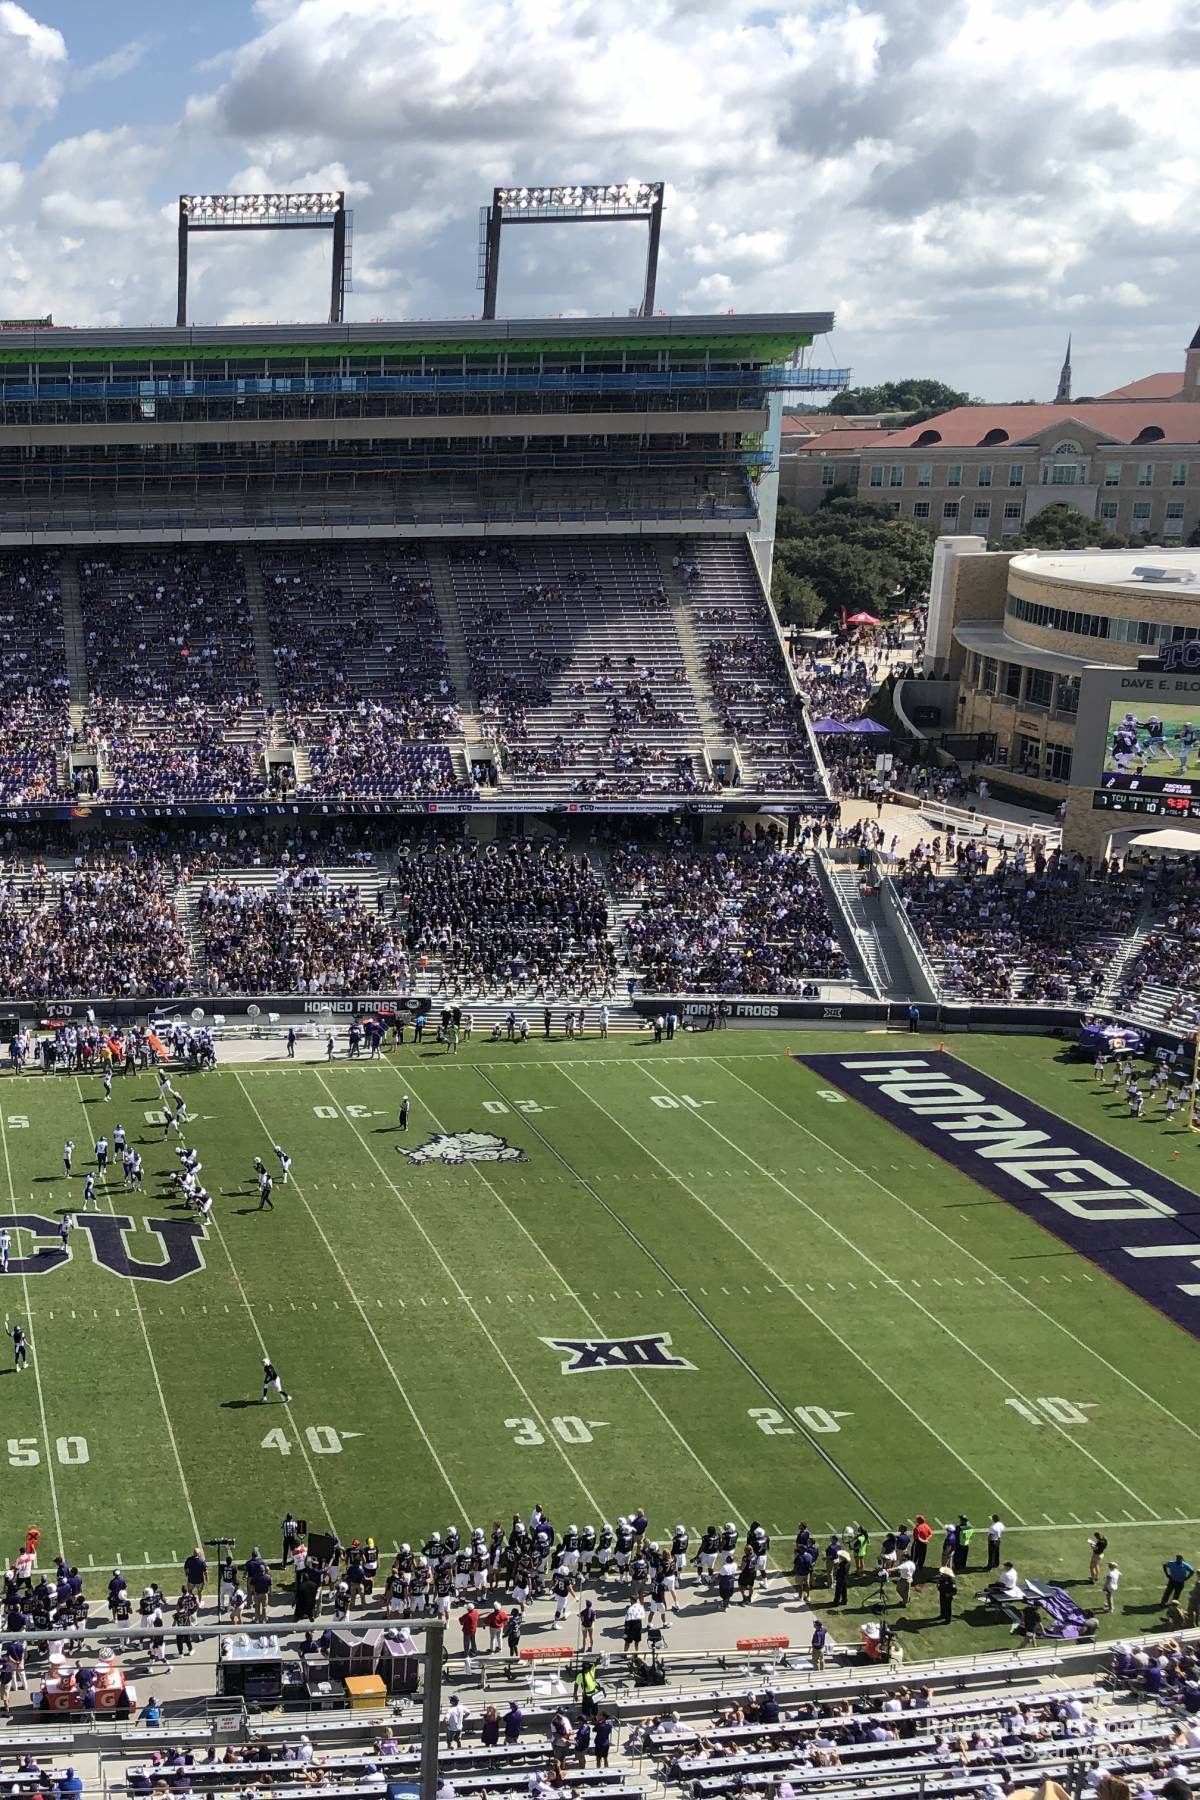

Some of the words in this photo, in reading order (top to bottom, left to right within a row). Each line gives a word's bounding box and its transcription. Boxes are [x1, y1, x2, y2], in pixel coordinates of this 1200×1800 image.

[1121, 679, 1153, 689] DAVE
[1159, 681, 1169, 690] E.
[1102, 796, 1108, 804] 7
[1112, 794, 1127, 803] TCU
[1168, 798, 1190, 808] 9:39
[1147, 803, 1156, 812] 10
[1183, 809, 1189, 817] 3
[47, 1005, 72, 1016] TCU
[304, 1001, 352, 1012] HORNED
[357, 1001, 397, 1012] FROGS
[737, 1006, 779, 1016] FROGS
[483, 1099, 543, 1114] 20
[651, 1096, 702, 1109] 10
[144, 1110, 198, 1125] 40
[314, 1104, 367, 1119] 30
[841, 1060, 1178, 1221] HORNED
[1005, 1397, 1089, 1426] 10
[747, 1406, 842, 1435] 20
[504, 1416, 594, 1445] 30
[260, 1426, 345, 1456] 40
[7, 1437, 89, 1467] 50
[117, 1606, 128, 1615] 31
[55, 1696, 69, 1709] G
[101, 1693, 115, 1707] G
